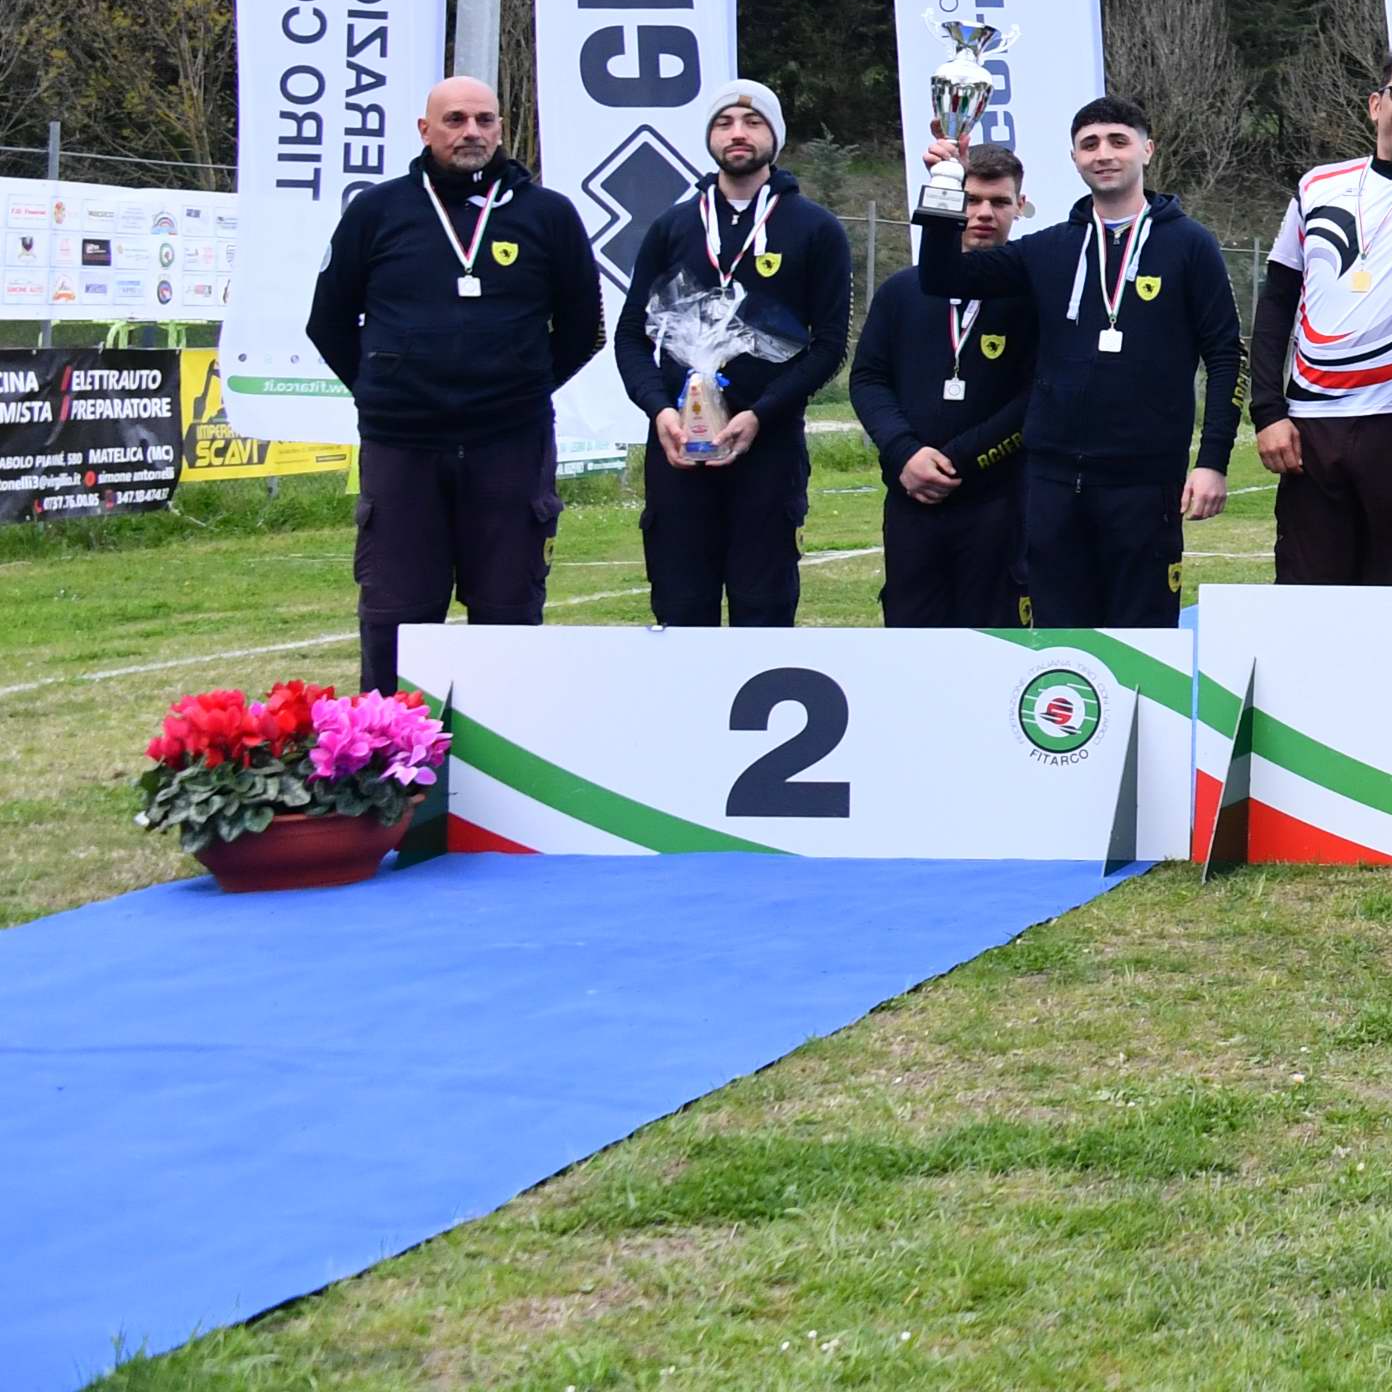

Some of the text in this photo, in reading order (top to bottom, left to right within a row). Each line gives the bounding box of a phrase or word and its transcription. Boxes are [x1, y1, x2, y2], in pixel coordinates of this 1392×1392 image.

[71, 369, 162, 392] ELETTRAUTO
[70, 397, 172, 421] PREPARATORE
[88, 447, 144, 464] MATELICA
[147, 445, 174, 463] (MC)
[195, 439, 259, 467] SCAVI
[725, 666, 851, 818] 2
[1030, 749, 1088, 766] FITARCO
